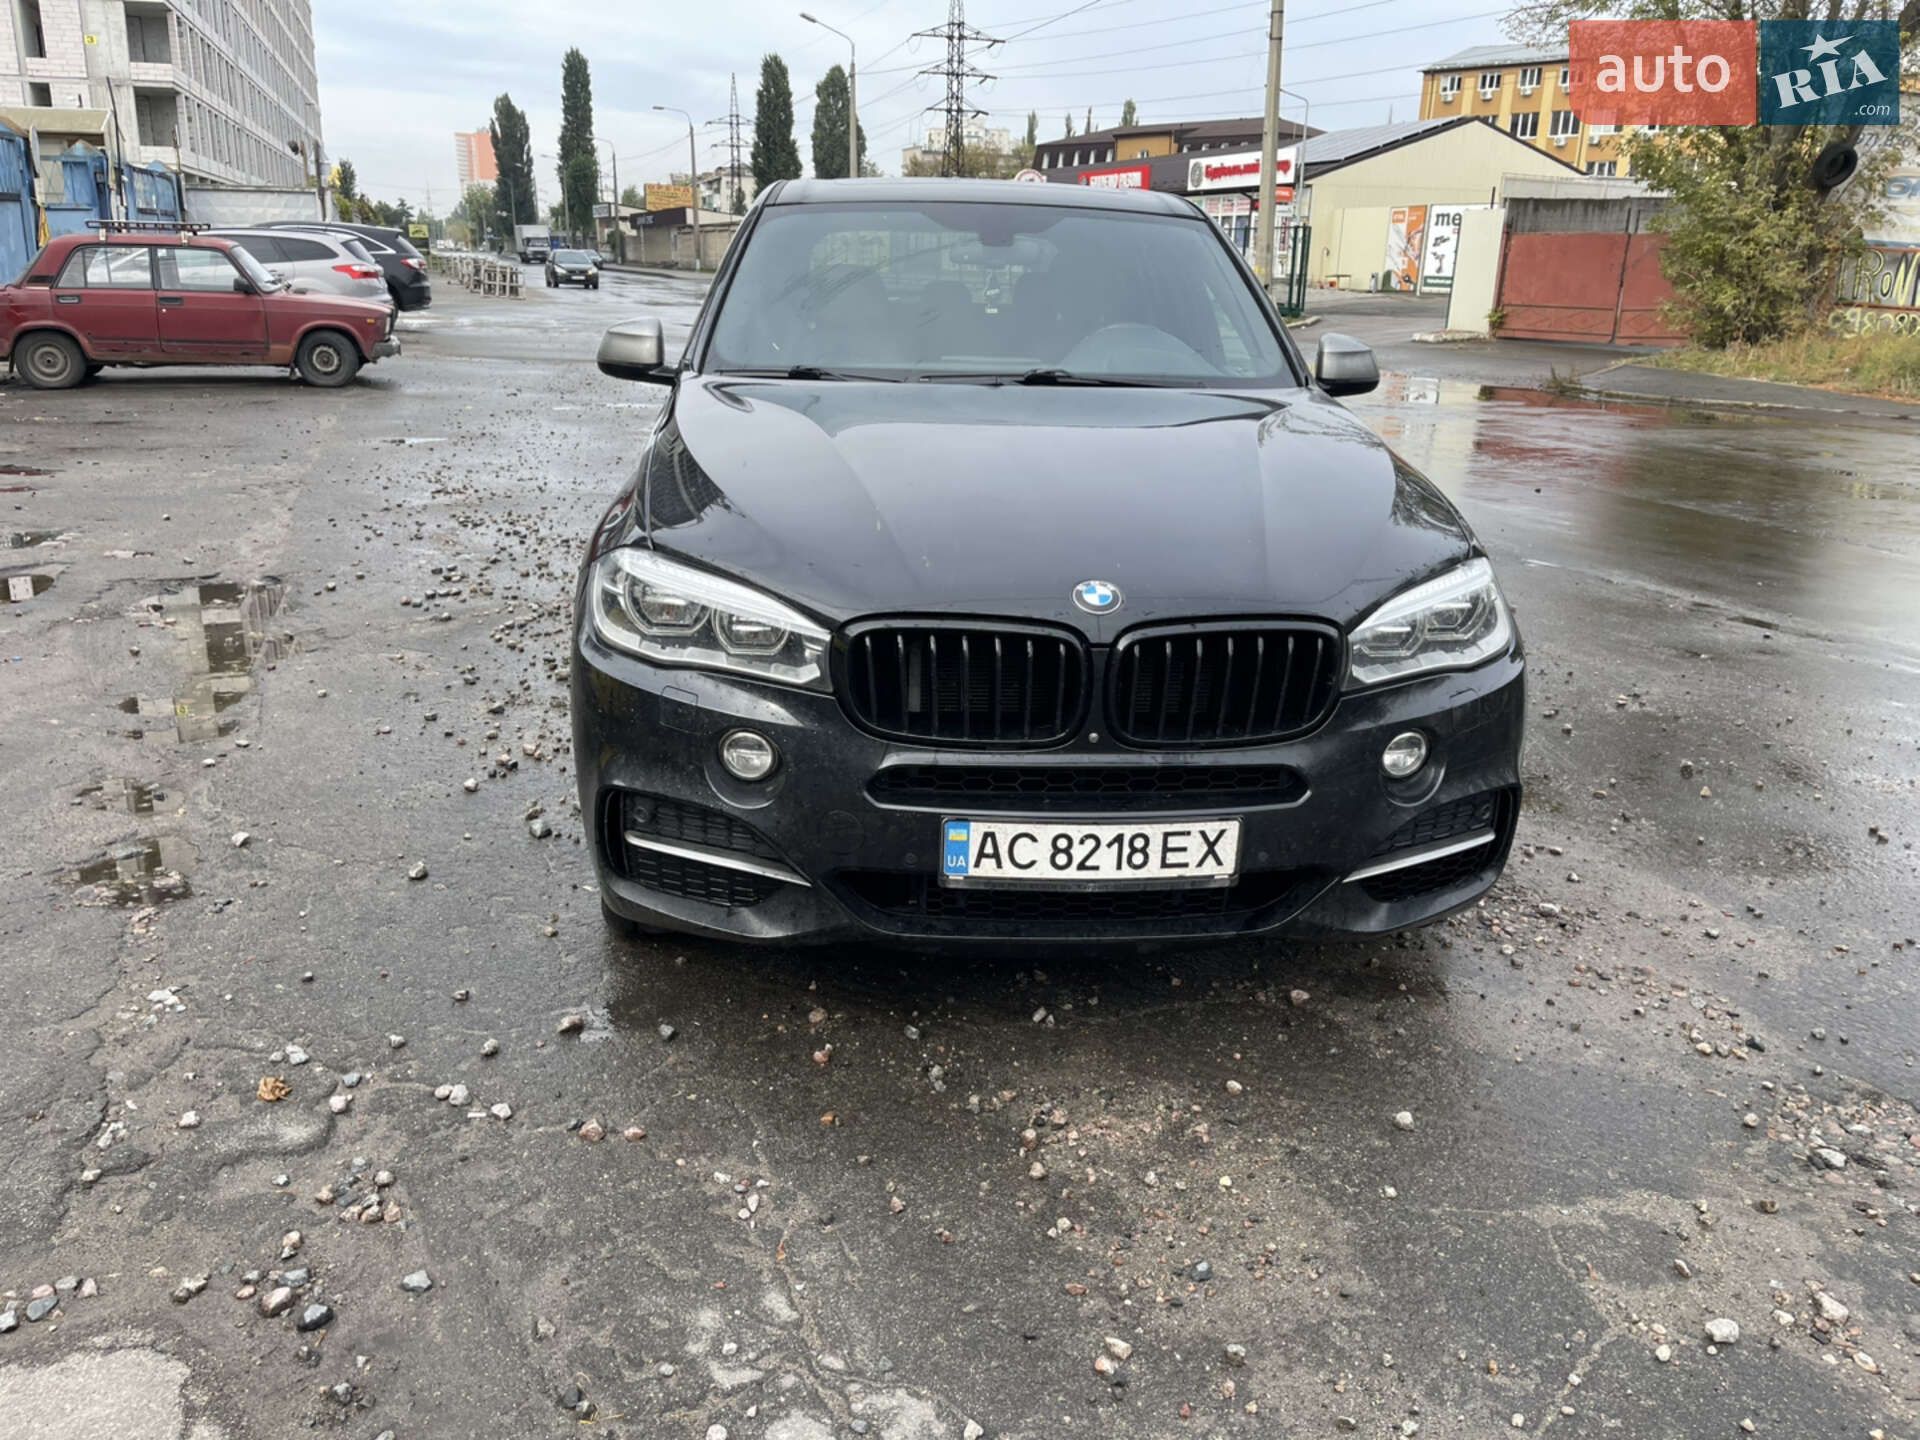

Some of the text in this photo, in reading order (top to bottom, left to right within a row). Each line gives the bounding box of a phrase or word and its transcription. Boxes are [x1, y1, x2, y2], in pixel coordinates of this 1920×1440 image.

[947, 855, 967, 868] UA
[973, 829, 1228, 871] AC 8218 EX
